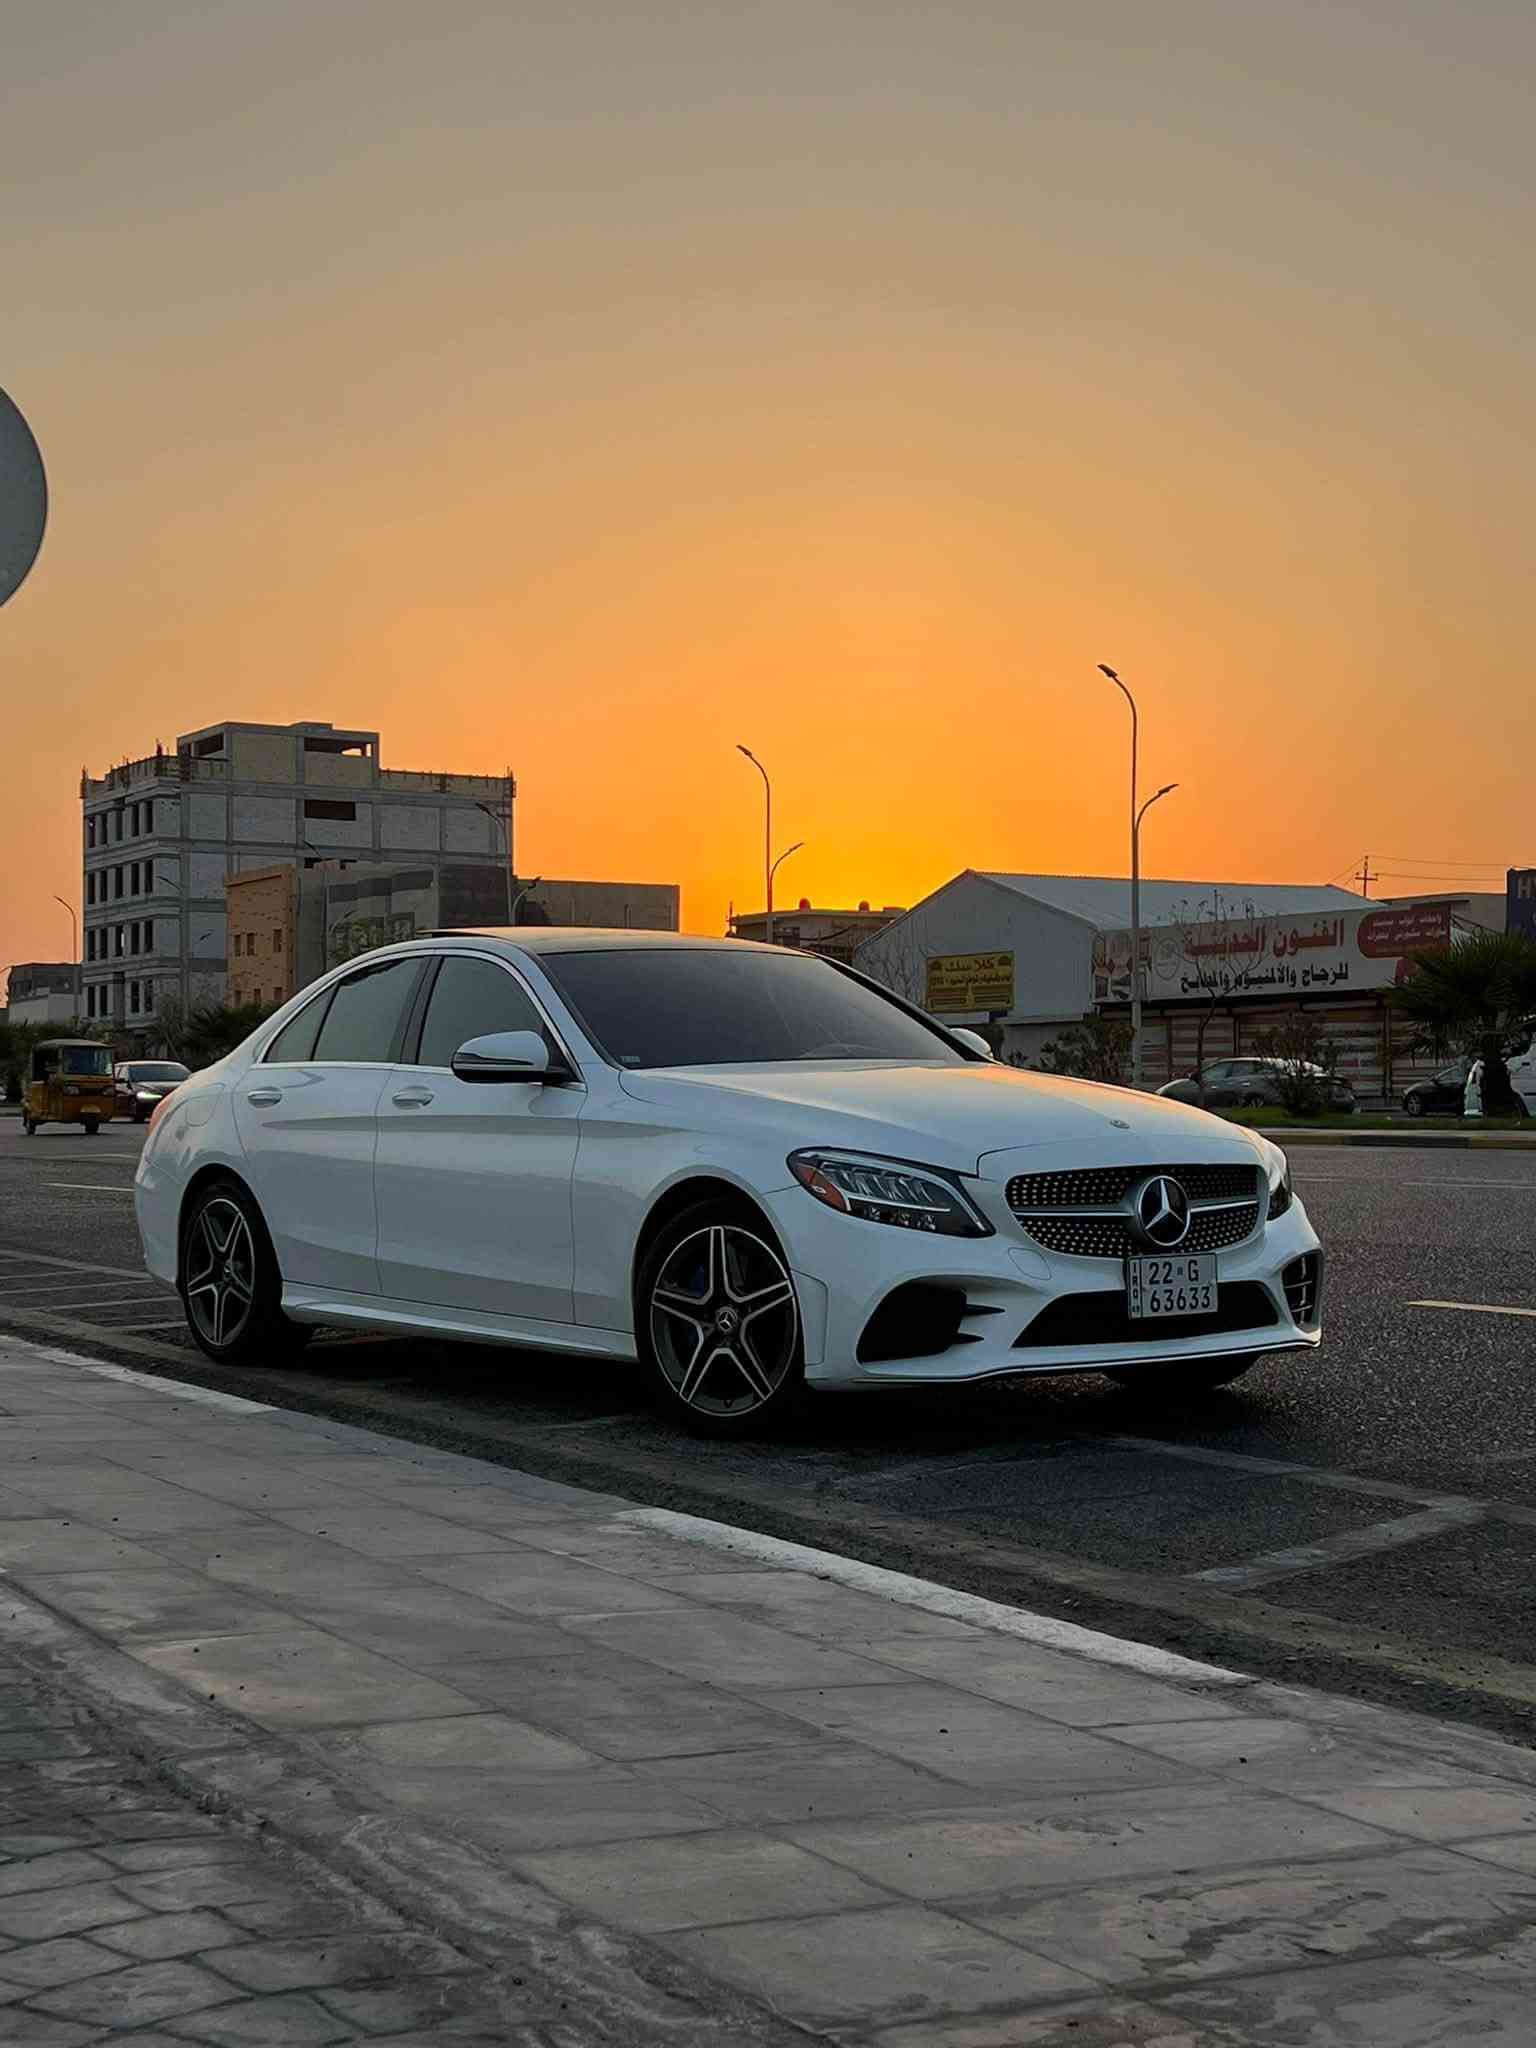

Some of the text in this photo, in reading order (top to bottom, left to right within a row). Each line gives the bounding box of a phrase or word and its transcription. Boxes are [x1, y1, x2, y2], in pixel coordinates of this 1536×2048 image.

[1272, 917, 1345, 959] الفنون
[1302, 961, 1349, 987] للزجاج
[1148, 1258, 1200, 1285] 22 G
[1150, 1286, 1211, 1313] 63633
